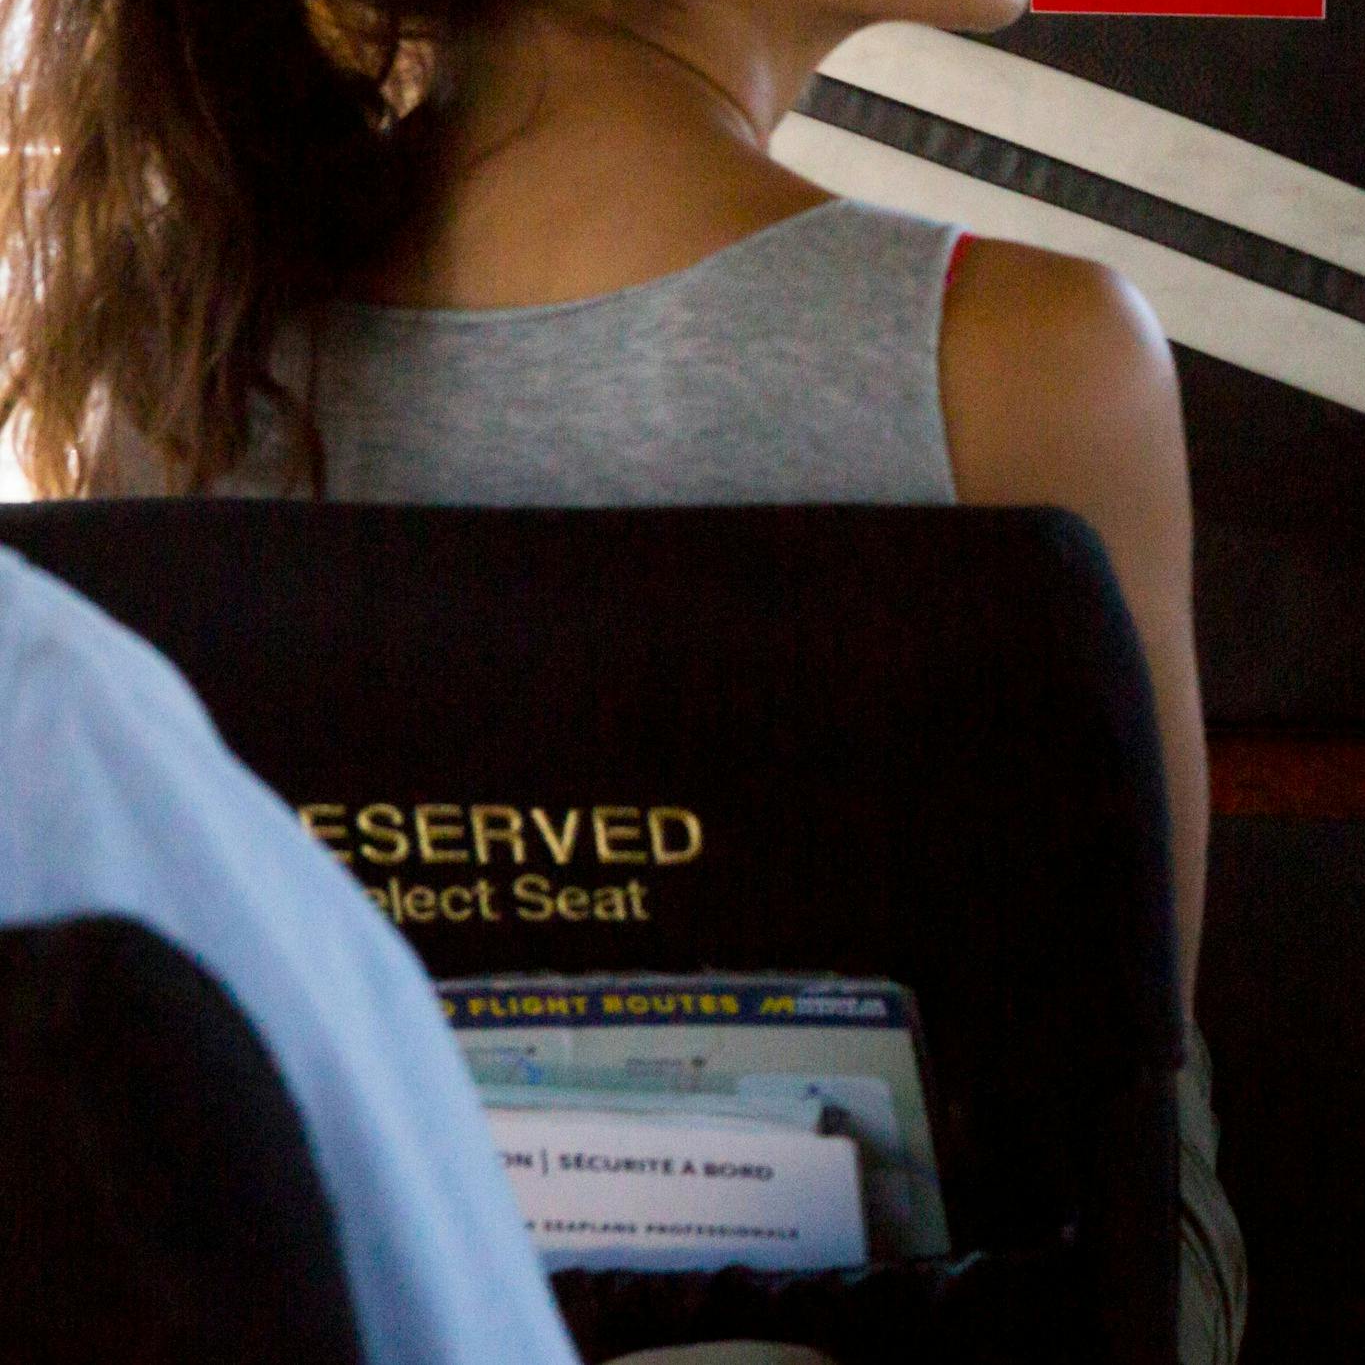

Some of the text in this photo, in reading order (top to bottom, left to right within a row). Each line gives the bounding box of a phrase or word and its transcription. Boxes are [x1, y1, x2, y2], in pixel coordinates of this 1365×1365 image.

[300, 804, 702, 865] ESERVED
[512, 874, 650, 922] Seat
[468, 995, 588, 1017] FLIGHT
[603, 995, 739, 1015] ROUTES
[704, 1161, 774, 1181] BORD
